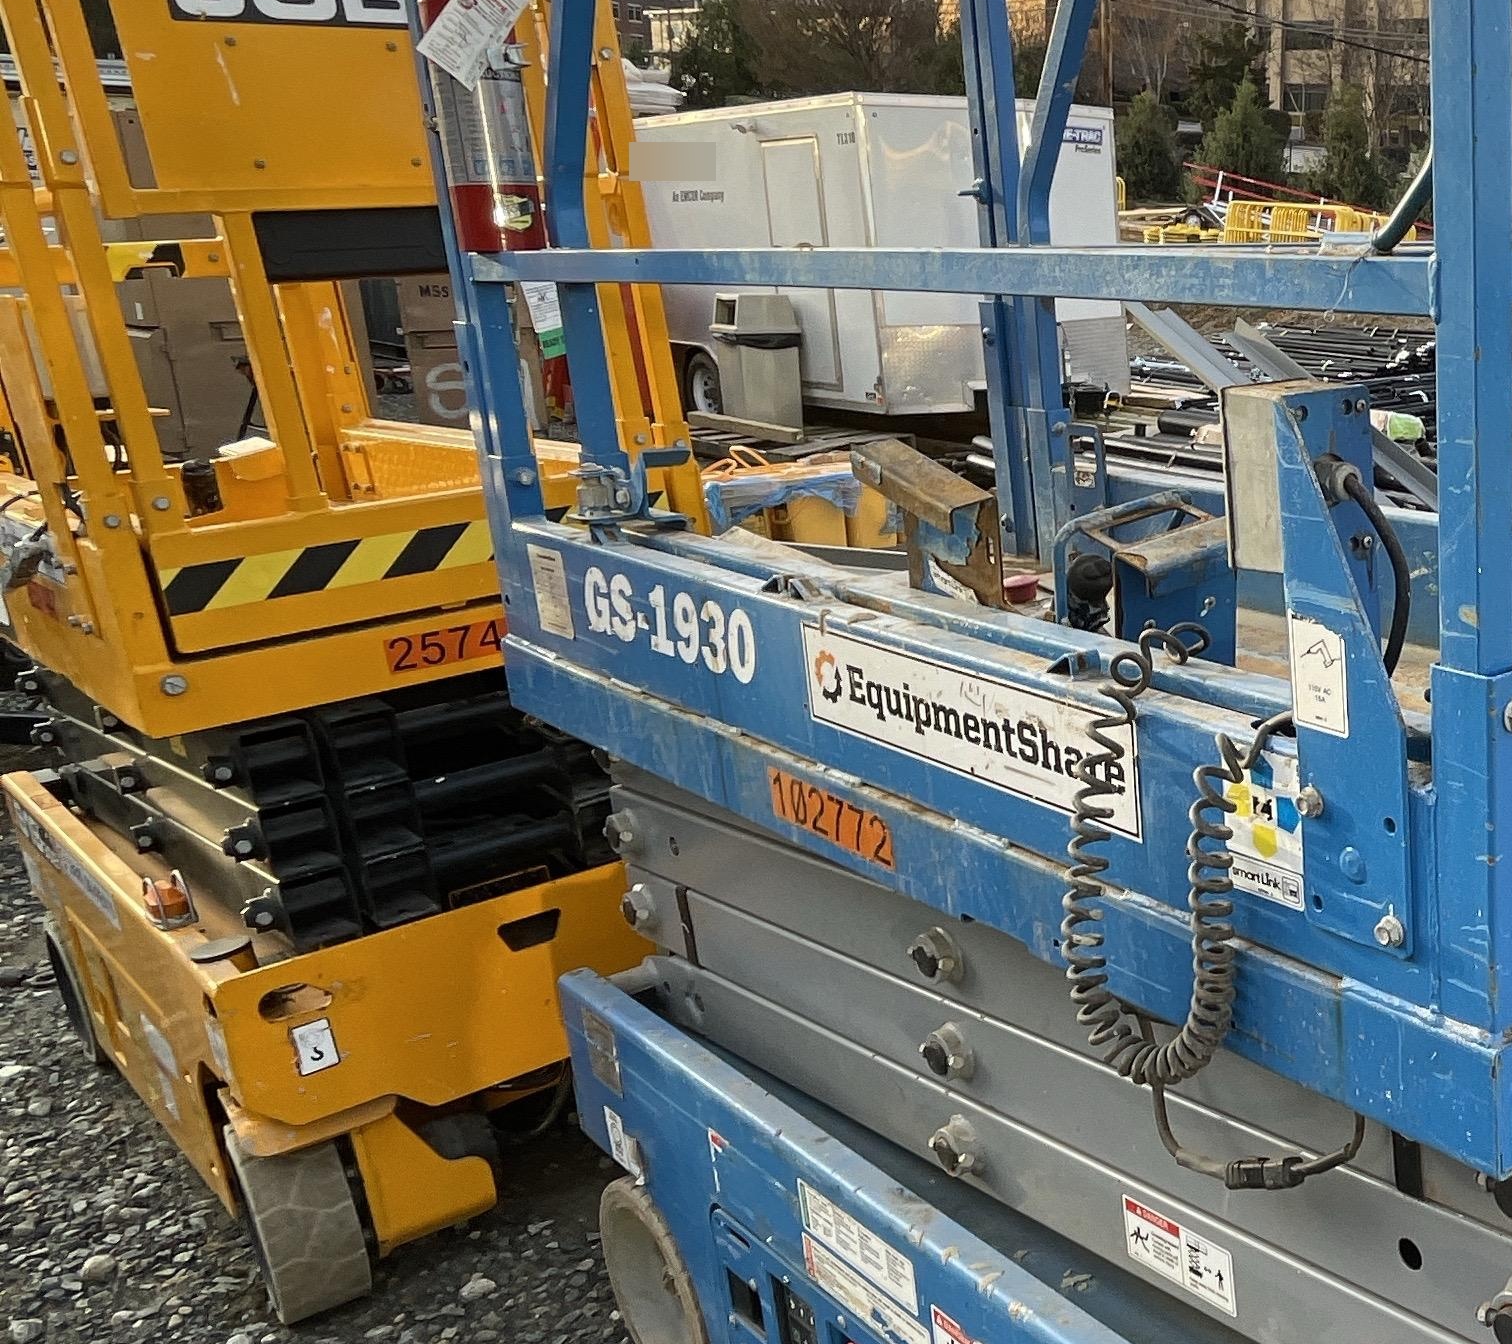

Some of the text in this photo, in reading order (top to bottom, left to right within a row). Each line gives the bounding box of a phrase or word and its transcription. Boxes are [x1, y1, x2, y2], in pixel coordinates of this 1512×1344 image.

[388, 619, 503, 672] 2574
[584, 566, 756, 684] GS-1930
[773, 772, 892, 867] 102772
